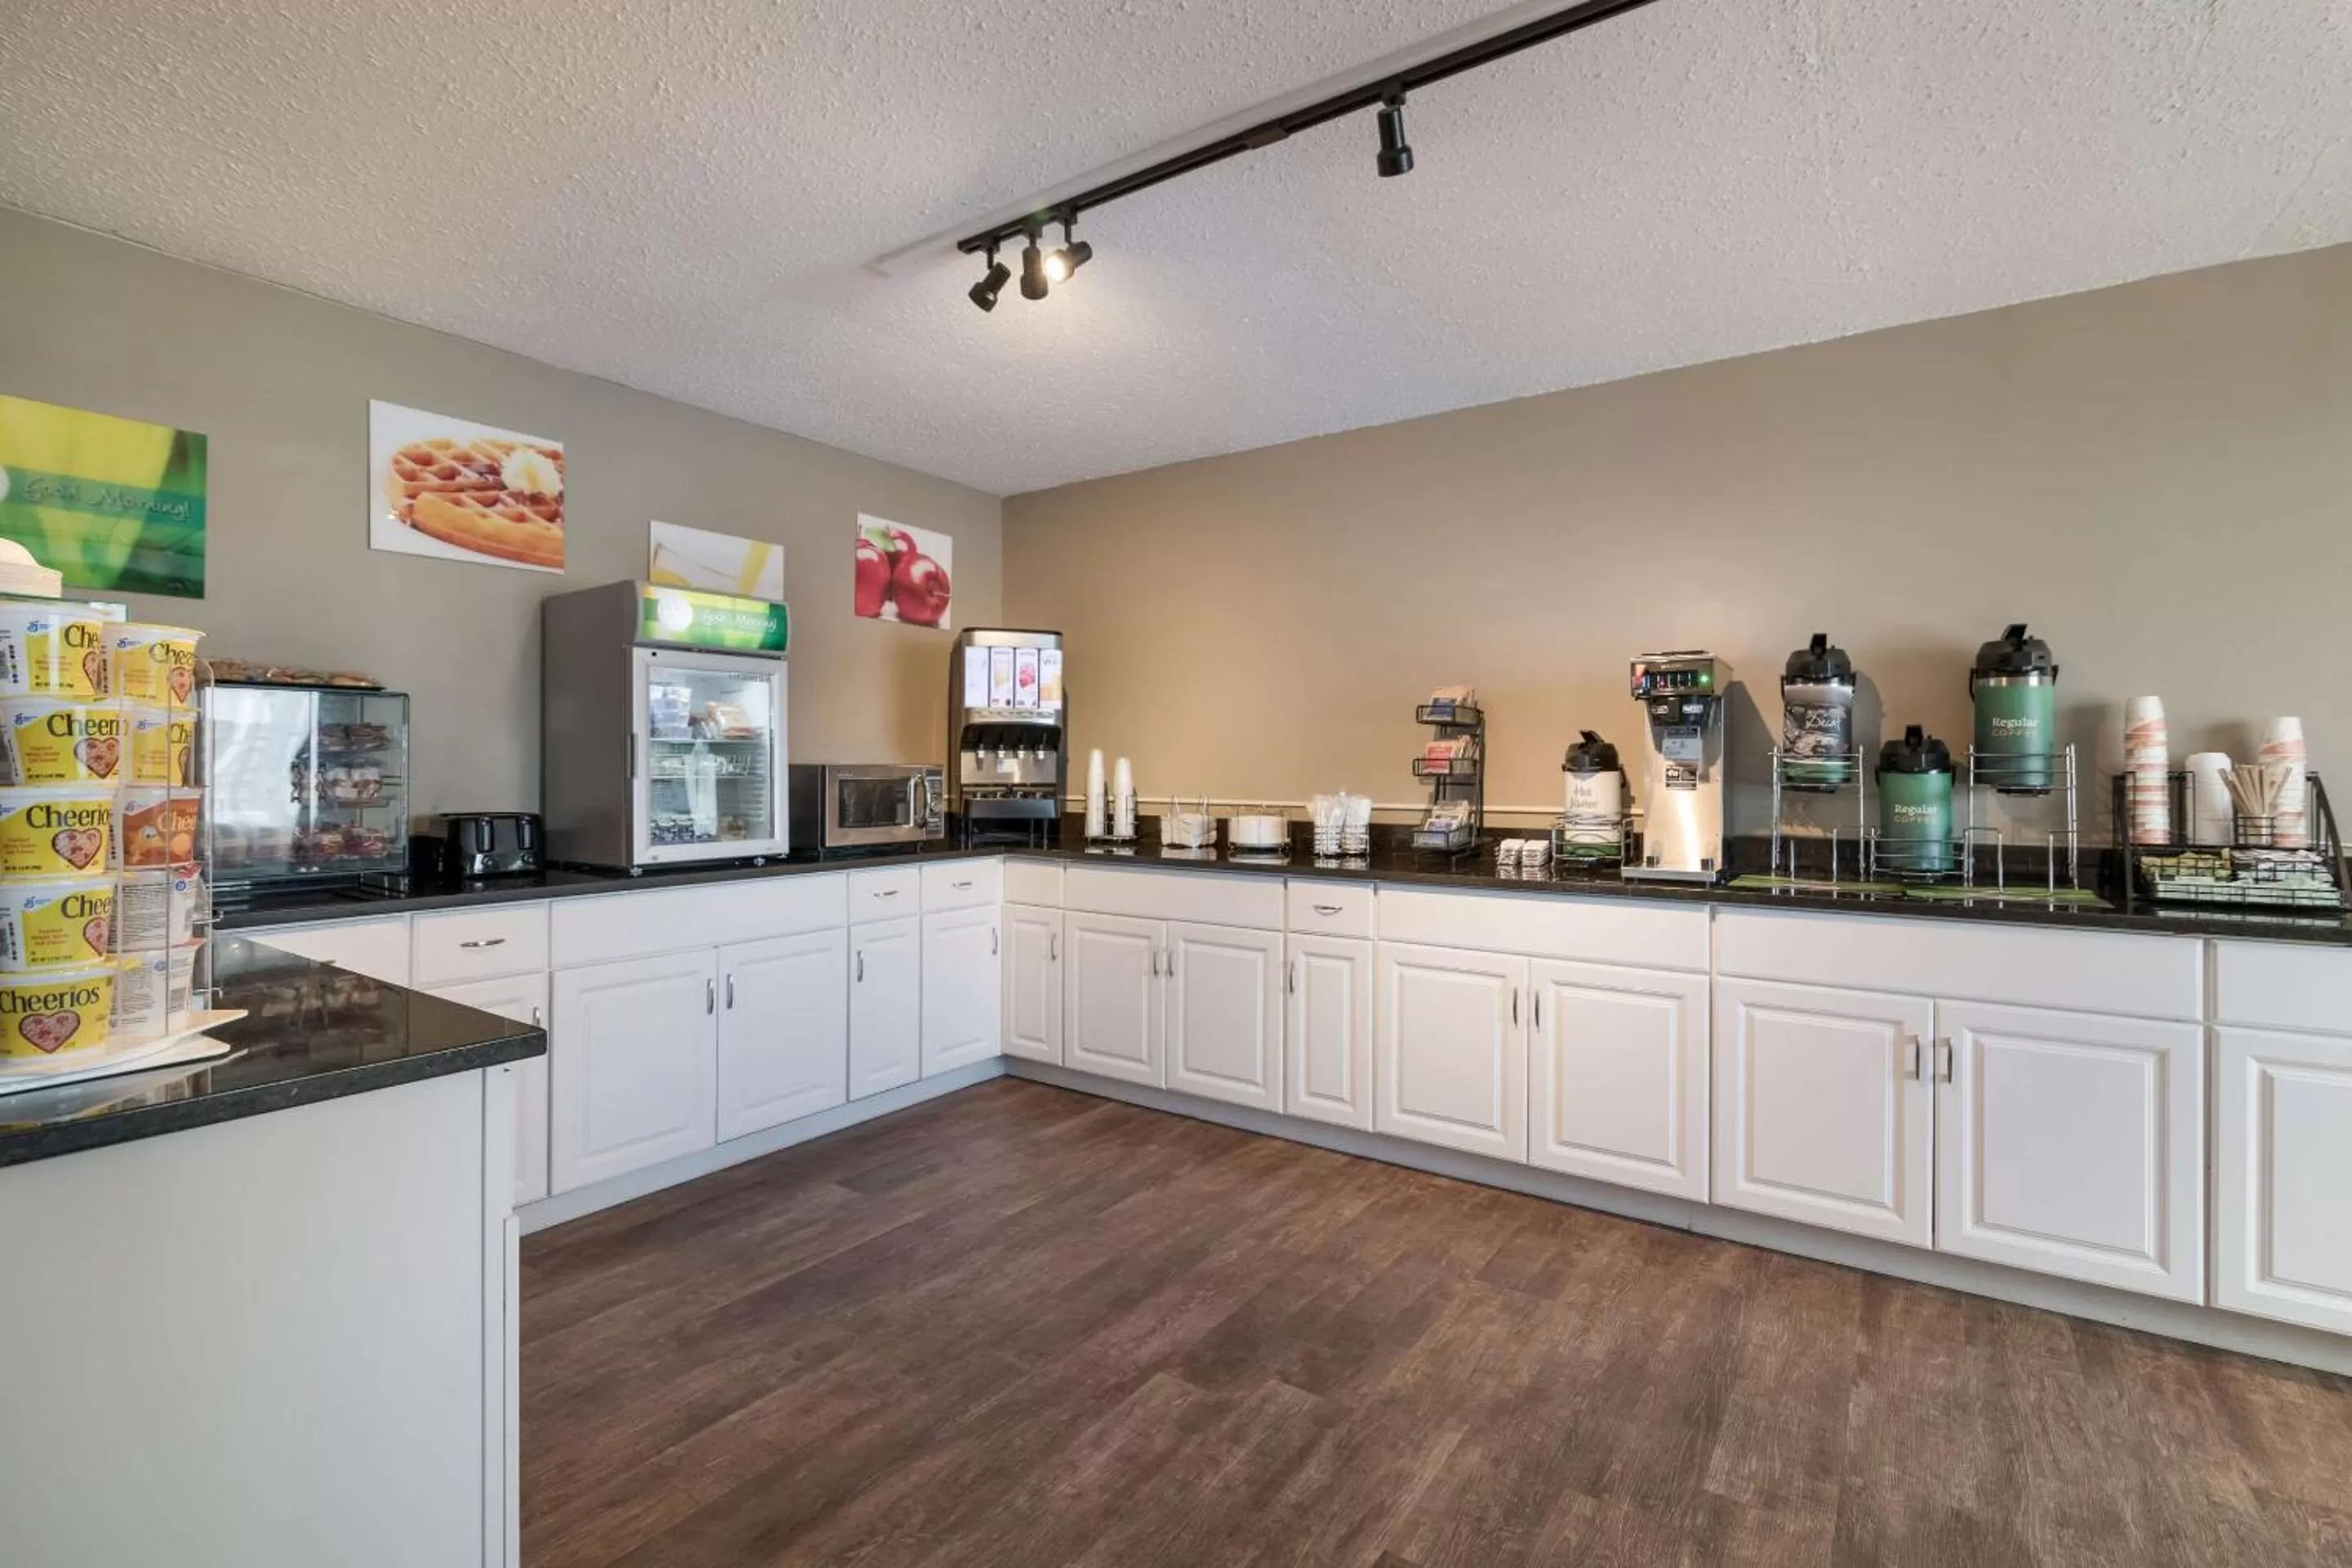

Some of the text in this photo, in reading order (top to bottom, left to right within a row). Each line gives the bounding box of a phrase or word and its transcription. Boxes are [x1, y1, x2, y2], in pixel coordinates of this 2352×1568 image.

[1992, 717, 2039, 728] Regular
[1895, 804, 1937, 816] Regular
[0, 986, 100, 1013] Cheerios
